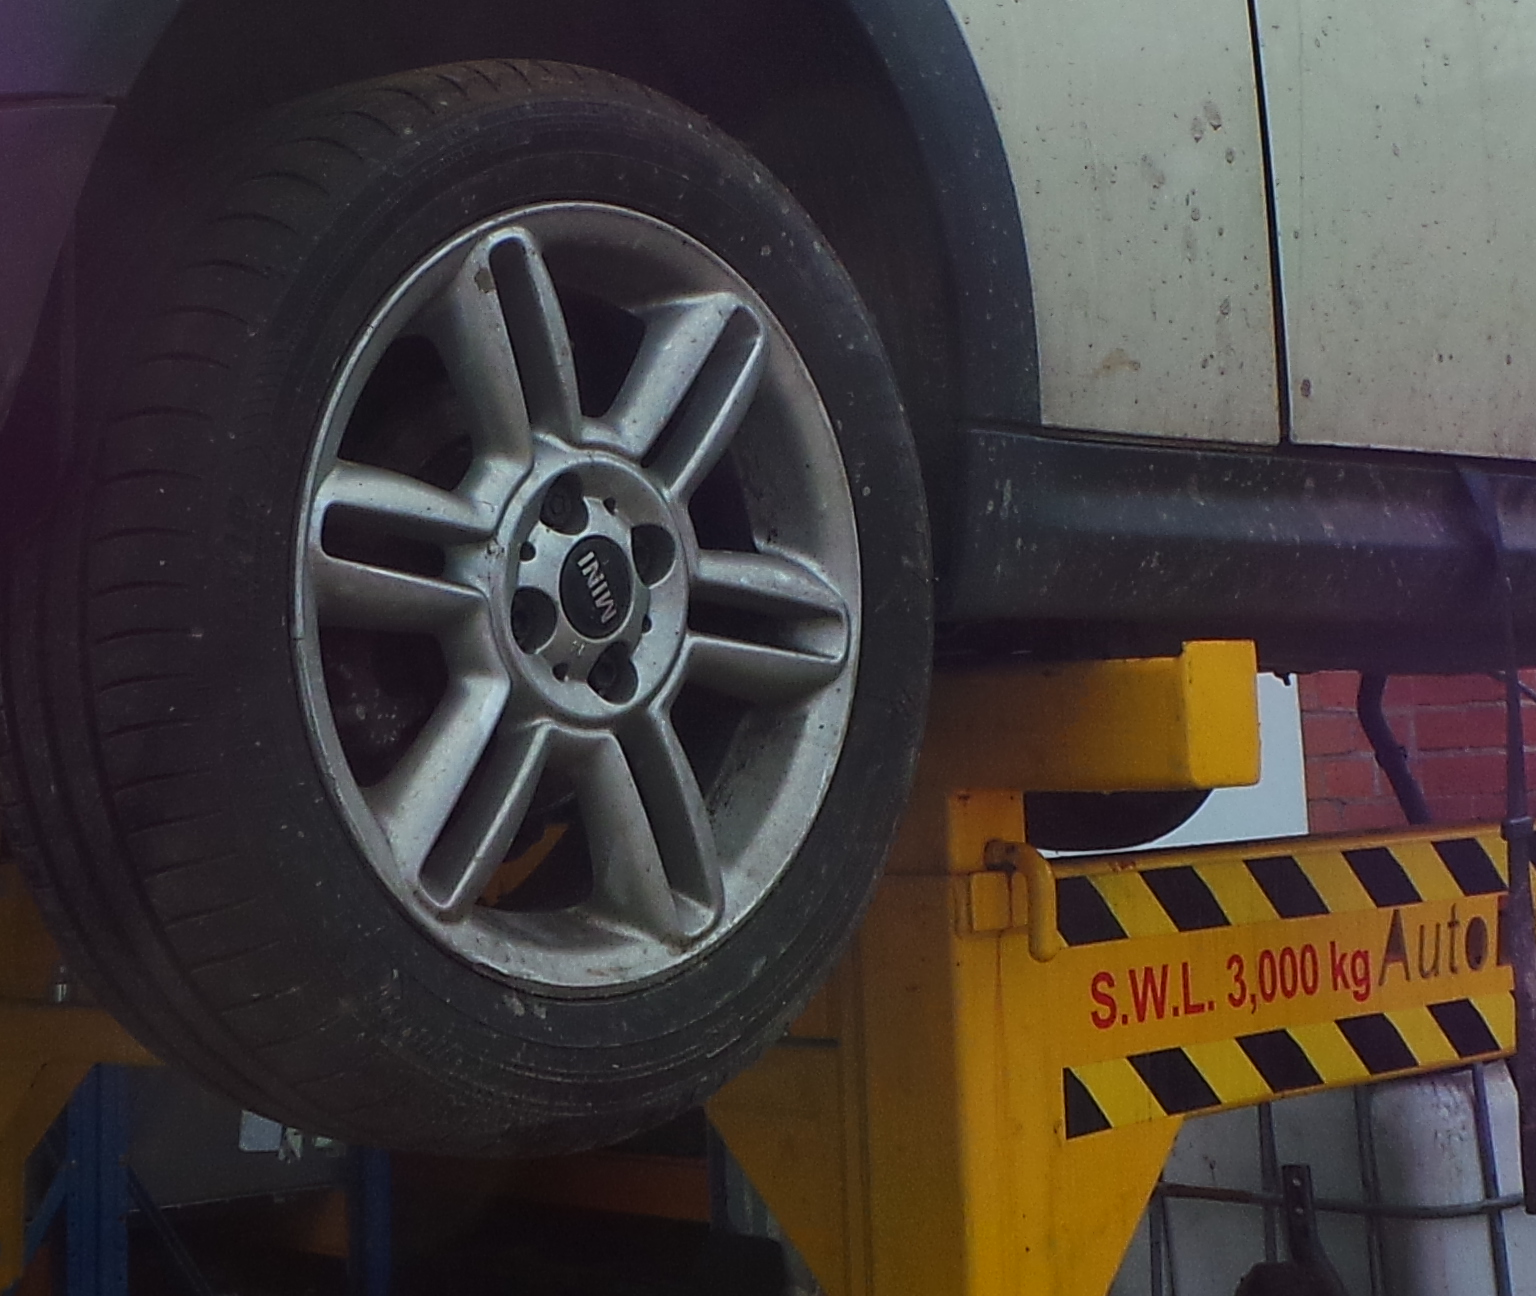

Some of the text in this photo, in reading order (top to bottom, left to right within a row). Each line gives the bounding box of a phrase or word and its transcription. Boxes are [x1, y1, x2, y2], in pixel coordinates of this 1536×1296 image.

[577, 551, 617, 623] MINI
[1090, 940, 1371, 1029] S.W.L. 3,000 kg
